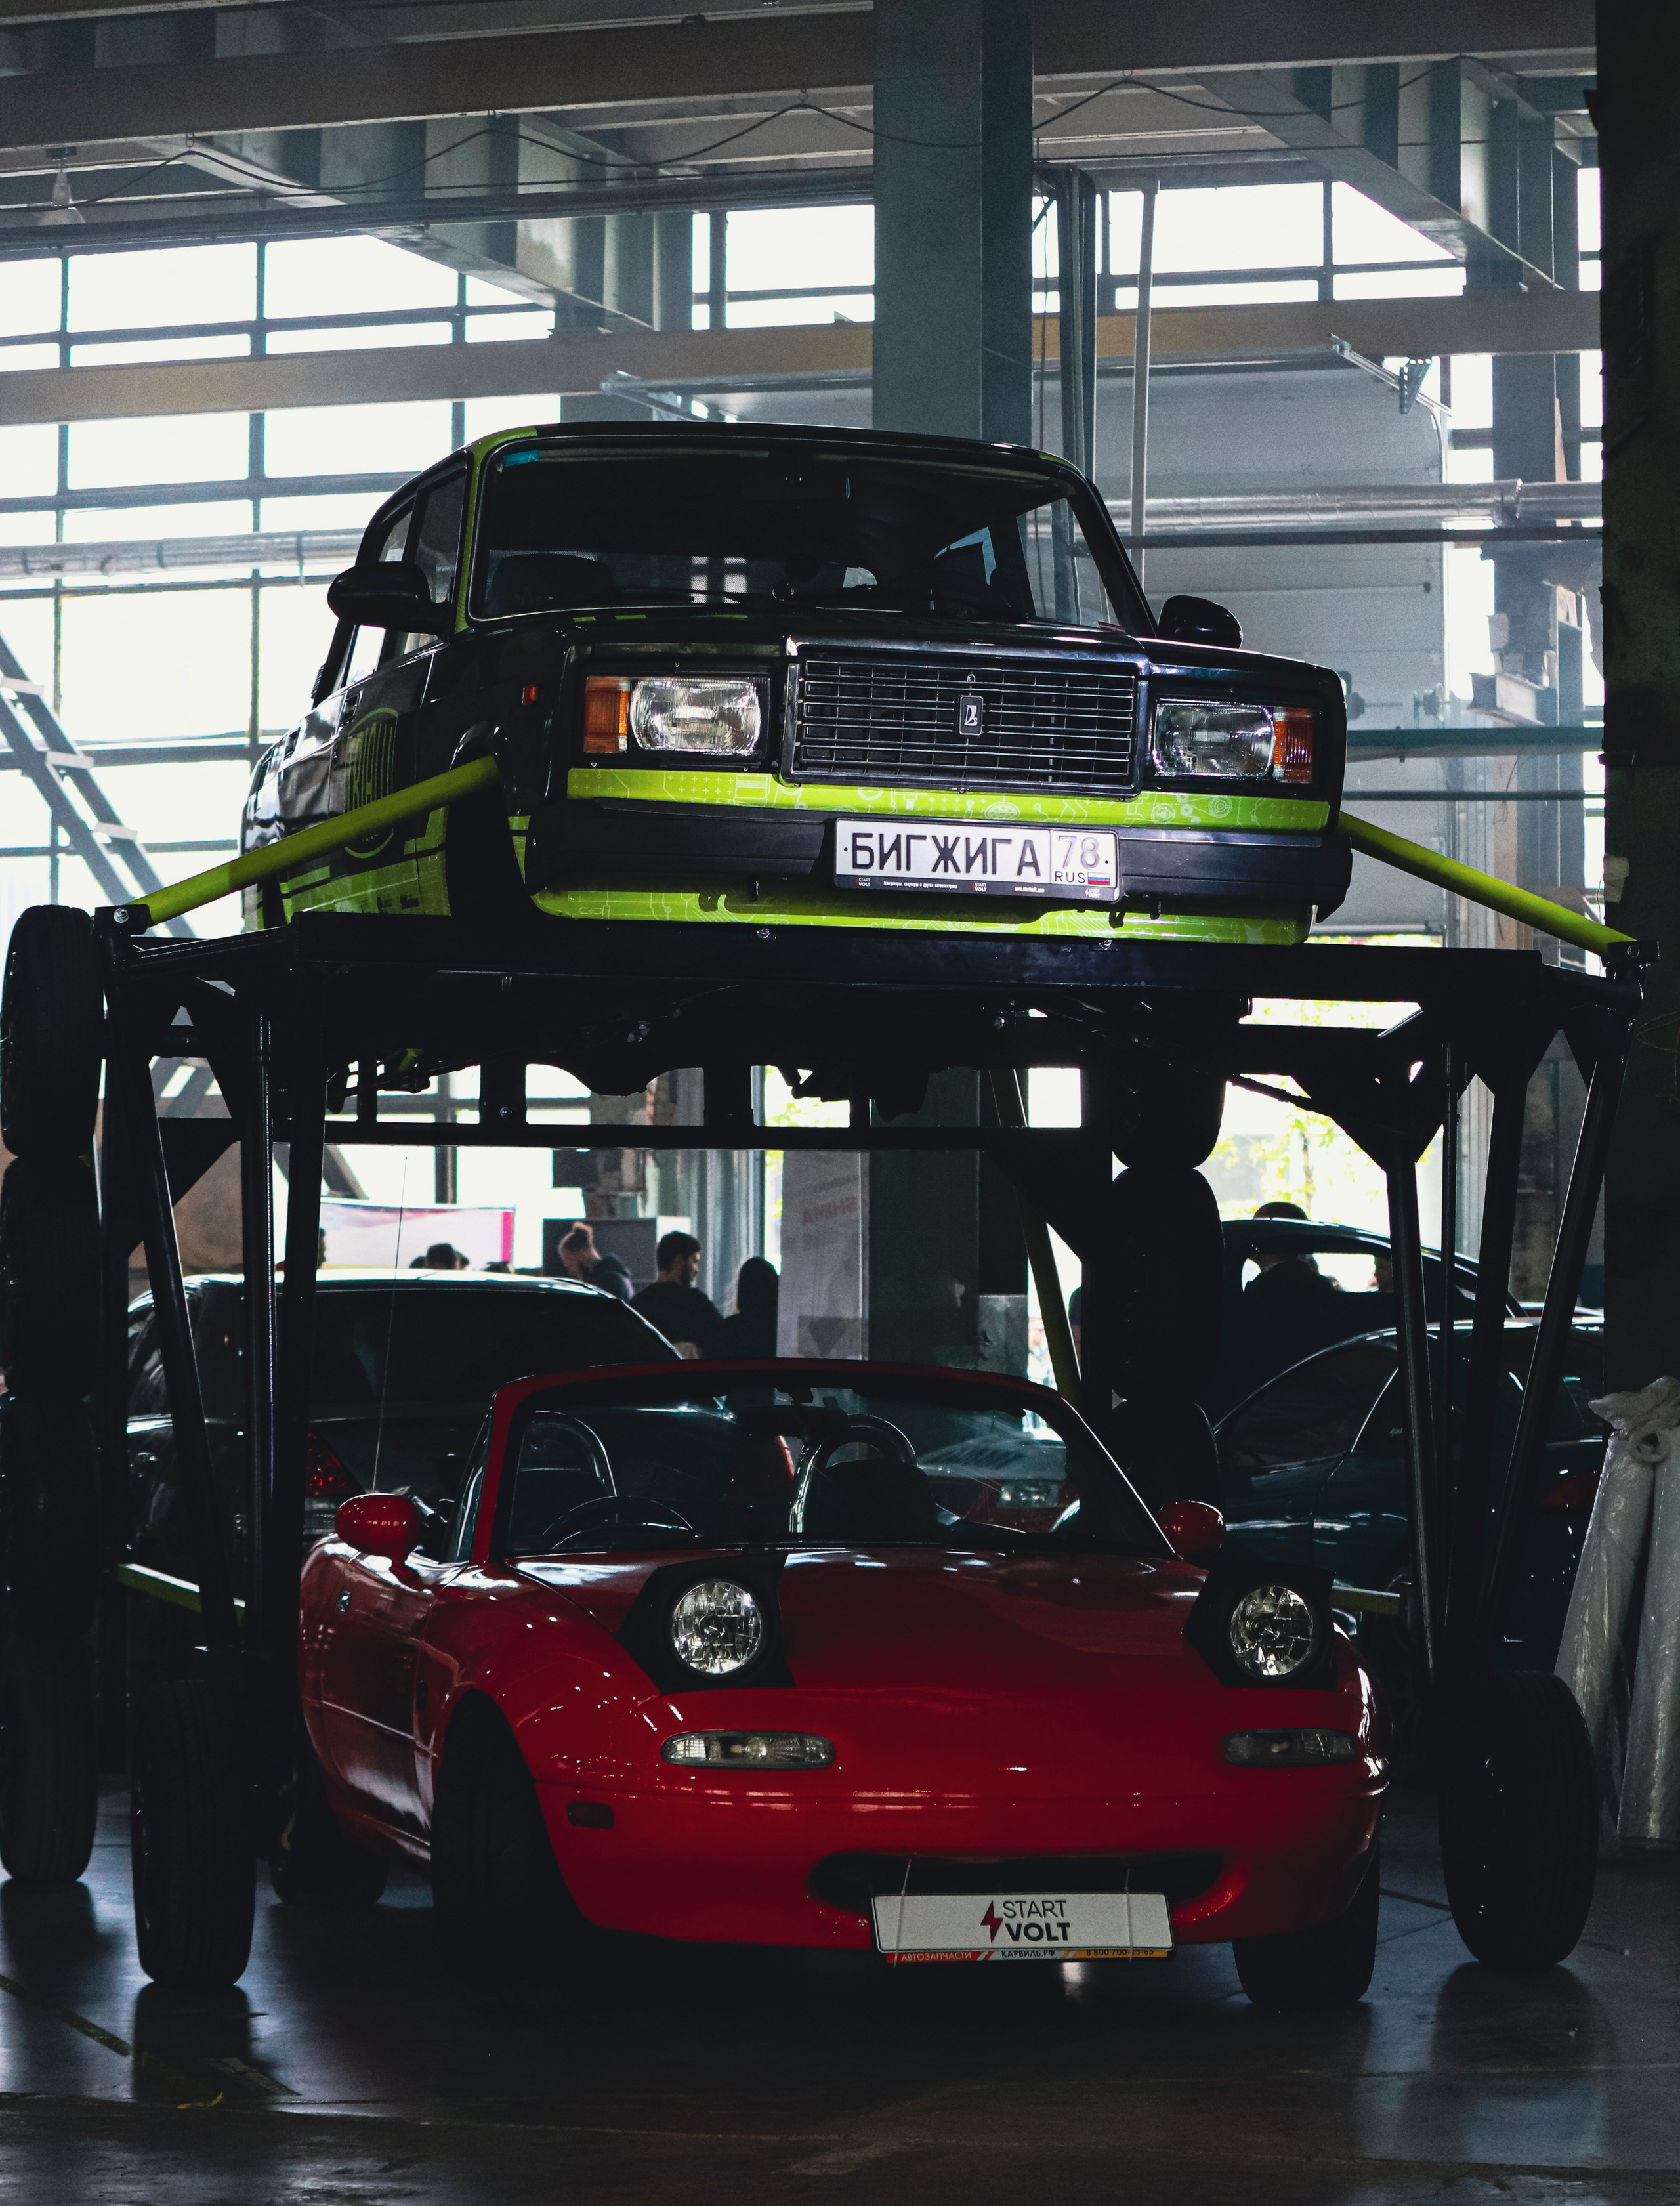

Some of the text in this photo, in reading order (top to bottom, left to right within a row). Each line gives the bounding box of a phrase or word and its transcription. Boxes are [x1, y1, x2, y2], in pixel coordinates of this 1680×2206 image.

[852, 833, 1100, 876] БИГЖИГА 78
[1054, 871, 1086, 883] RUS
[1003, 1900, 1067, 1919] START
[1005, 1922, 1071, 1941] VOLT
[901, 1951, 972, 1961] АВТОЗАПЧАСТИ
[1001, 1950, 1055, 1959] КАРВИЛЬ.РФ
